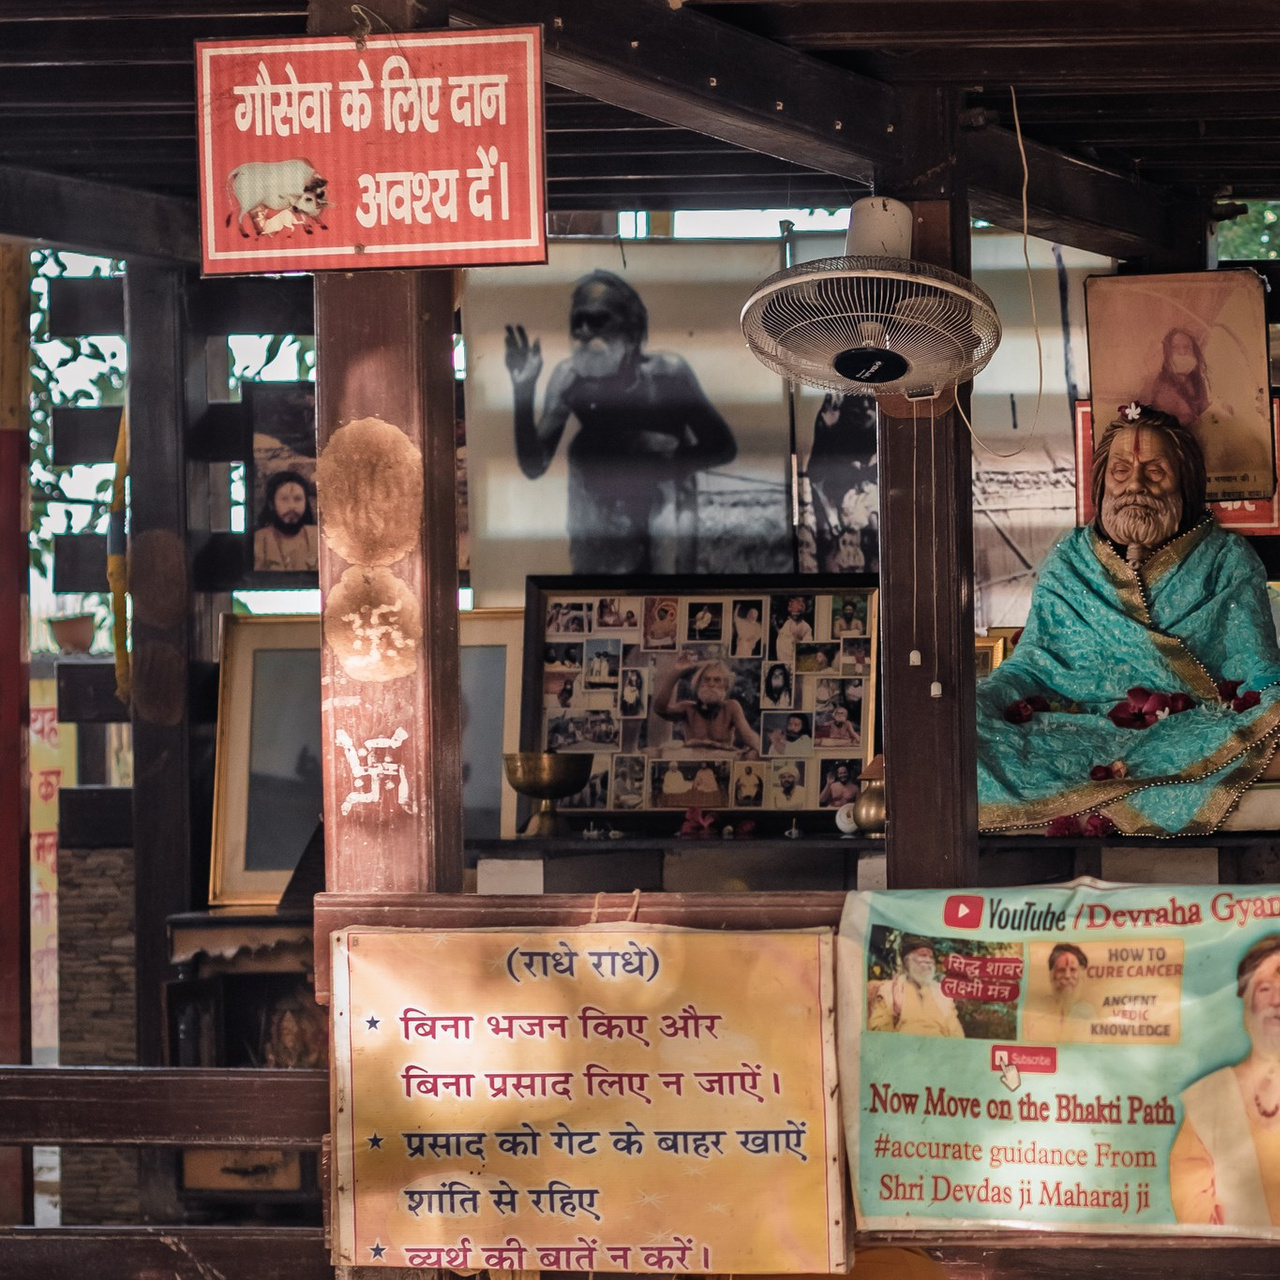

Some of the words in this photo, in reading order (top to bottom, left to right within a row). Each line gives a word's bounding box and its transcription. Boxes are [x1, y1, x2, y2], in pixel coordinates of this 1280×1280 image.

[233, 60, 333, 137] गौसेवा
[338, 58, 374, 132] के
[381, 54, 442, 134] लिए
[448, 74, 509, 127] दान
[355, 168, 460, 228] अवश्य
[988, 897, 1067, 932] YouTube
[1087, 965, 1125, 979] CURE
[1127, 963, 1184, 978] CANCER
[1108, 948, 1145, 962] HOW
[1148, 947, 1166, 961] TO
[988, 982, 1012, 999] मंत्र
[1102, 995, 1158, 1007] ANCIENT
[400, 1007, 474, 1041] बिना
[487, 1015, 569, 1041] भजन
[578, 1006, 652, 1048] किए
[659, 1005, 723, 1041] और
[1091, 1023, 1171, 1037] KNOWLEDGE
[1112, 1008, 1149, 1021] VEDIC
[1011, 1052, 1052, 1066] Subscribe
[401, 1065, 475, 1099] बिना
[487, 1072, 574, 1101] प्रसाद
[583, 1063, 652, 1105] लिए
[657, 1072, 684, 1097] न
[869, 1082, 920, 1116] Now
[924, 1086, 980, 1119] Move
[986, 1095, 1012, 1120] on
[1018, 1094, 1051, 1123] the
[1055, 1093, 1123, 1124] Bhakti
[1127, 1095, 1177, 1126] Path
[402, 1131, 488, 1162] प्रसाद
[494, 1121, 539, 1157] को
[550, 1121, 601, 1157] गेट
[609, 1120, 645, 1157] के
[655, 1130, 728, 1159] बाहर
[874, 1133, 984, 1163] #accurate
[989, 1139, 1089, 1169] guidance
[1095, 1141, 1158, 1169] From
[403, 1180, 481, 1218] शांति
[487, 1180, 521, 1213] से
[528, 1181, 602, 1221] रहिए
[879, 1174, 925, 1202] Shri
[930, 1176, 1012, 1204] Devdas
[1017, 1177, 1033, 1209] ji
[1039, 1179, 1131, 1213] Maharaj
[1134, 1182, 1151, 1213] ji
[404, 1237, 473, 1270] व्यर्थ
[480, 1236, 528, 1270] की
[535, 1236, 598, 1271] बातें
[605, 1246, 632, 1271] न
